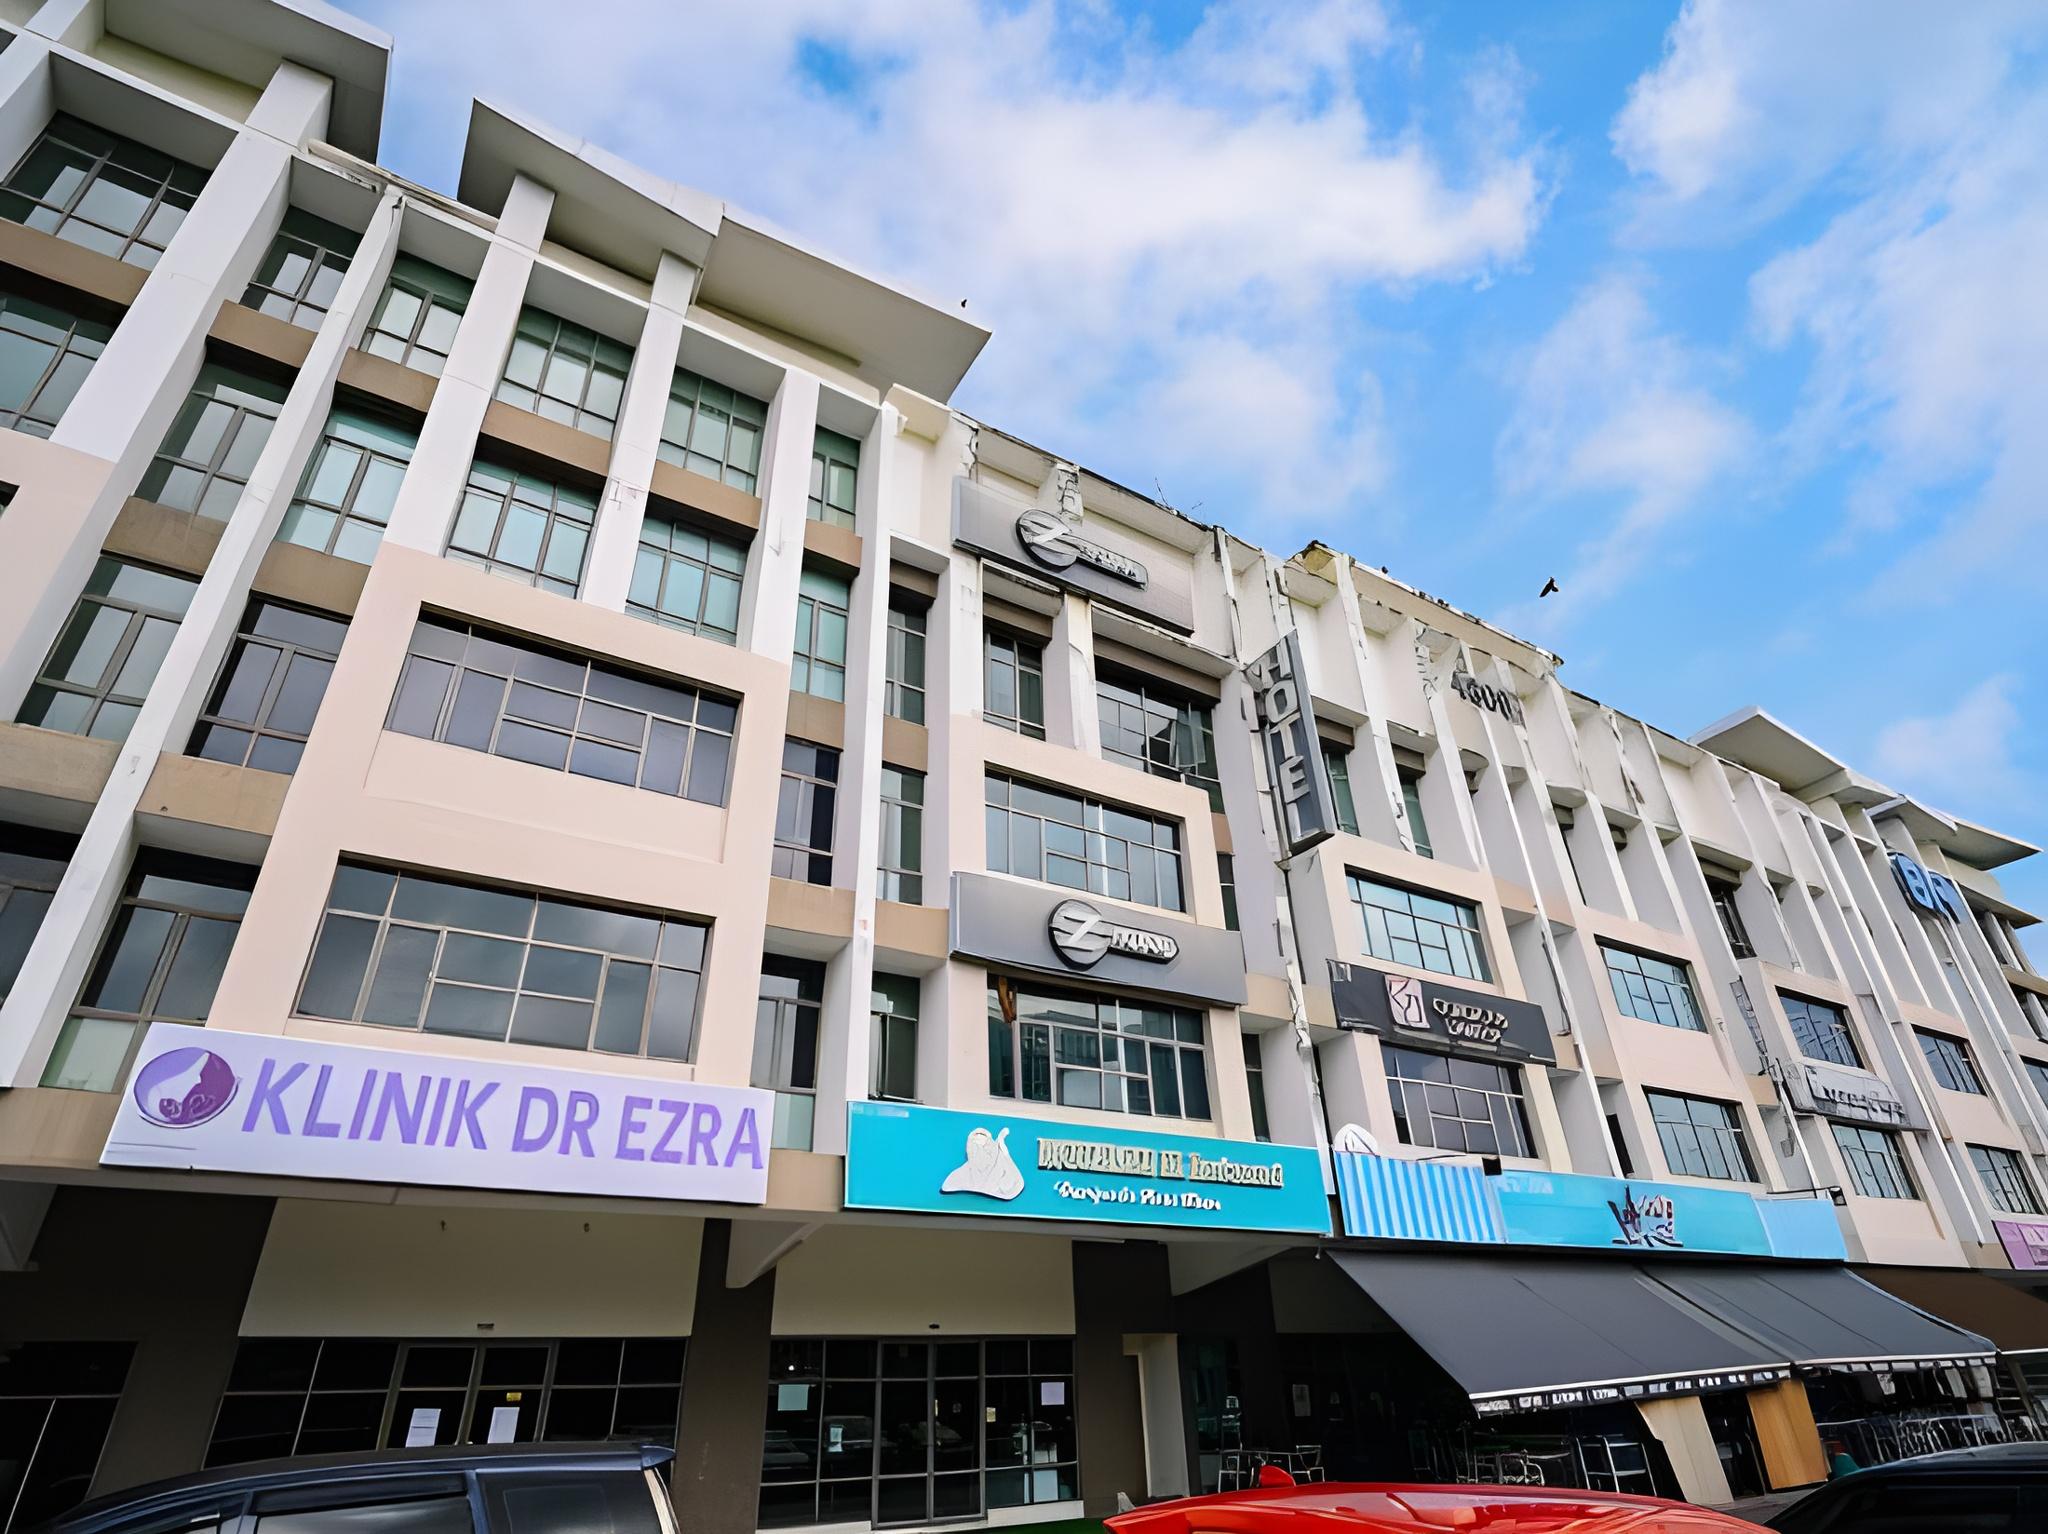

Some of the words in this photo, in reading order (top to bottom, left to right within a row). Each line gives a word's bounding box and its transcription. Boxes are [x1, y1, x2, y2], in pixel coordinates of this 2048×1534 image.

[241, 1057, 501, 1151] KLINIK
[511, 1086, 600, 1158] DR
[614, 1095, 764, 1170] EZRA
